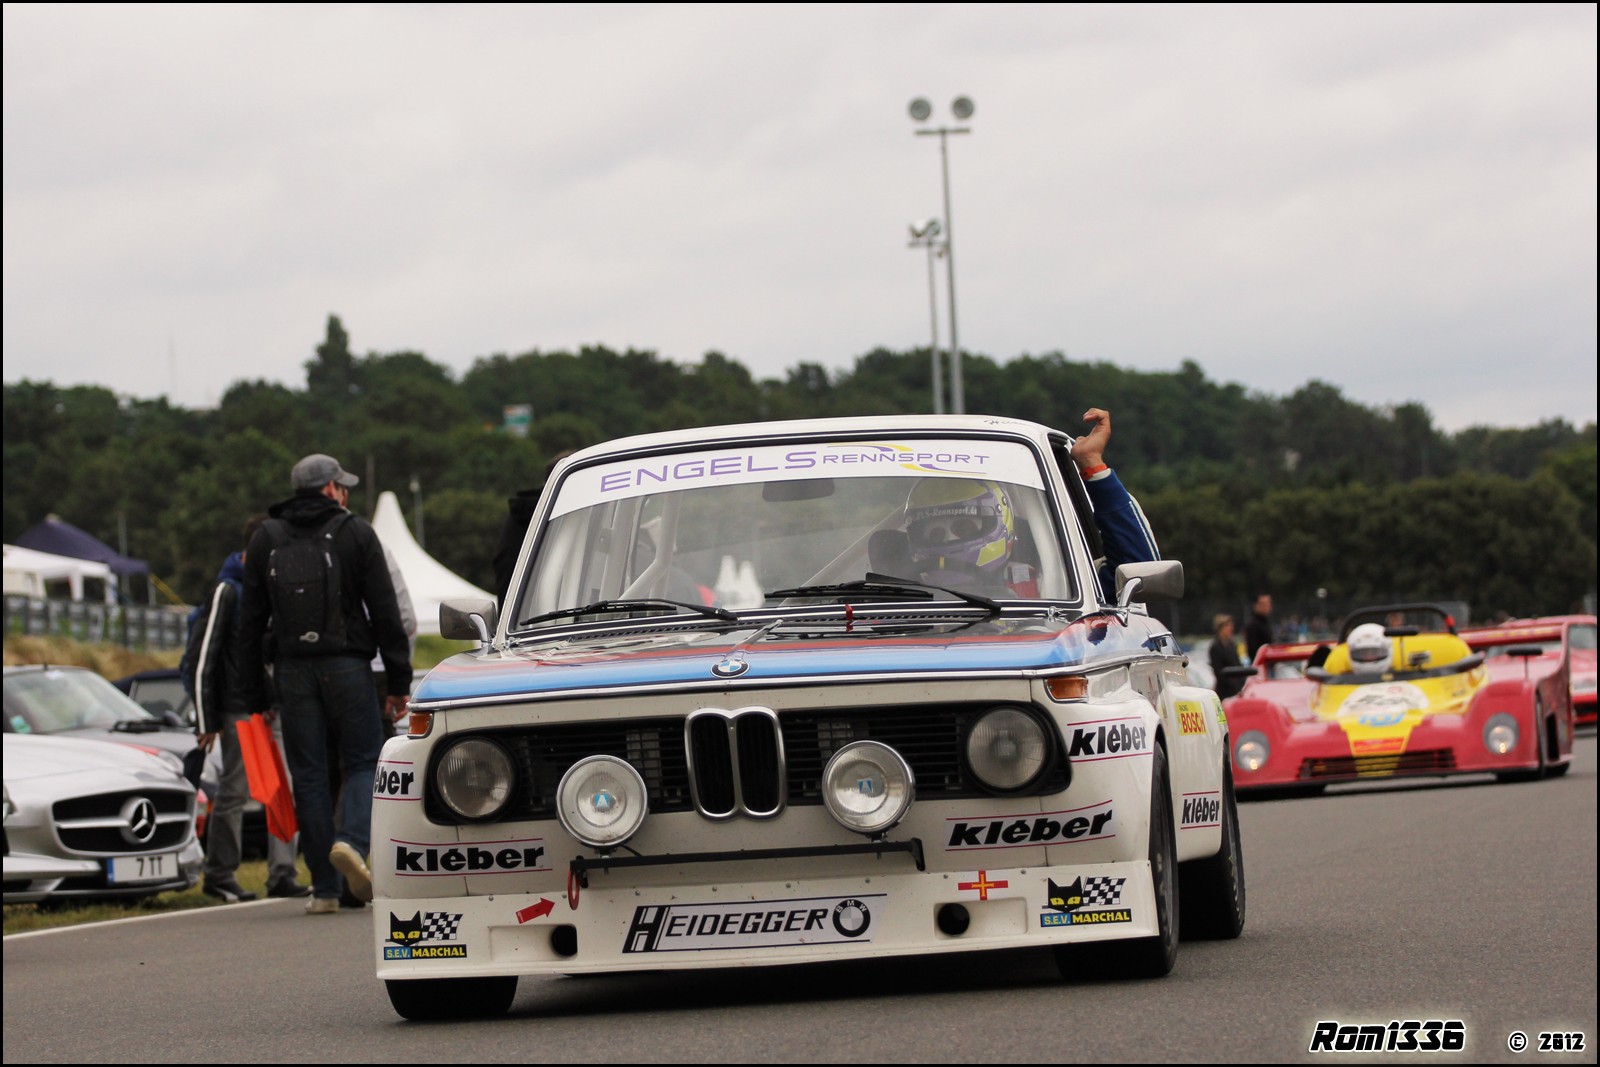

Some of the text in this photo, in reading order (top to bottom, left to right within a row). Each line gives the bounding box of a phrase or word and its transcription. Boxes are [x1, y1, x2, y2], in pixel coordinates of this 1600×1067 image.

[600, 451, 990, 492] ENGELS RENNSPORT
[1180, 712, 1207, 733] BOSCH
[1069, 724, 1147, 757] kléber
[1181, 797, 1220, 824] kléber
[948, 809, 1113, 847] kléber
[136, 855, 163, 877] 7 TT
[396, 846, 545, 872] kléber
[835, 899, 868, 913] BMW
[1044, 911, 1130, 925] S.E.V. MARCHAL
[622, 905, 829, 953] HEIDEGGER
[386, 946, 465, 958] S.E.V. MARCHAL
